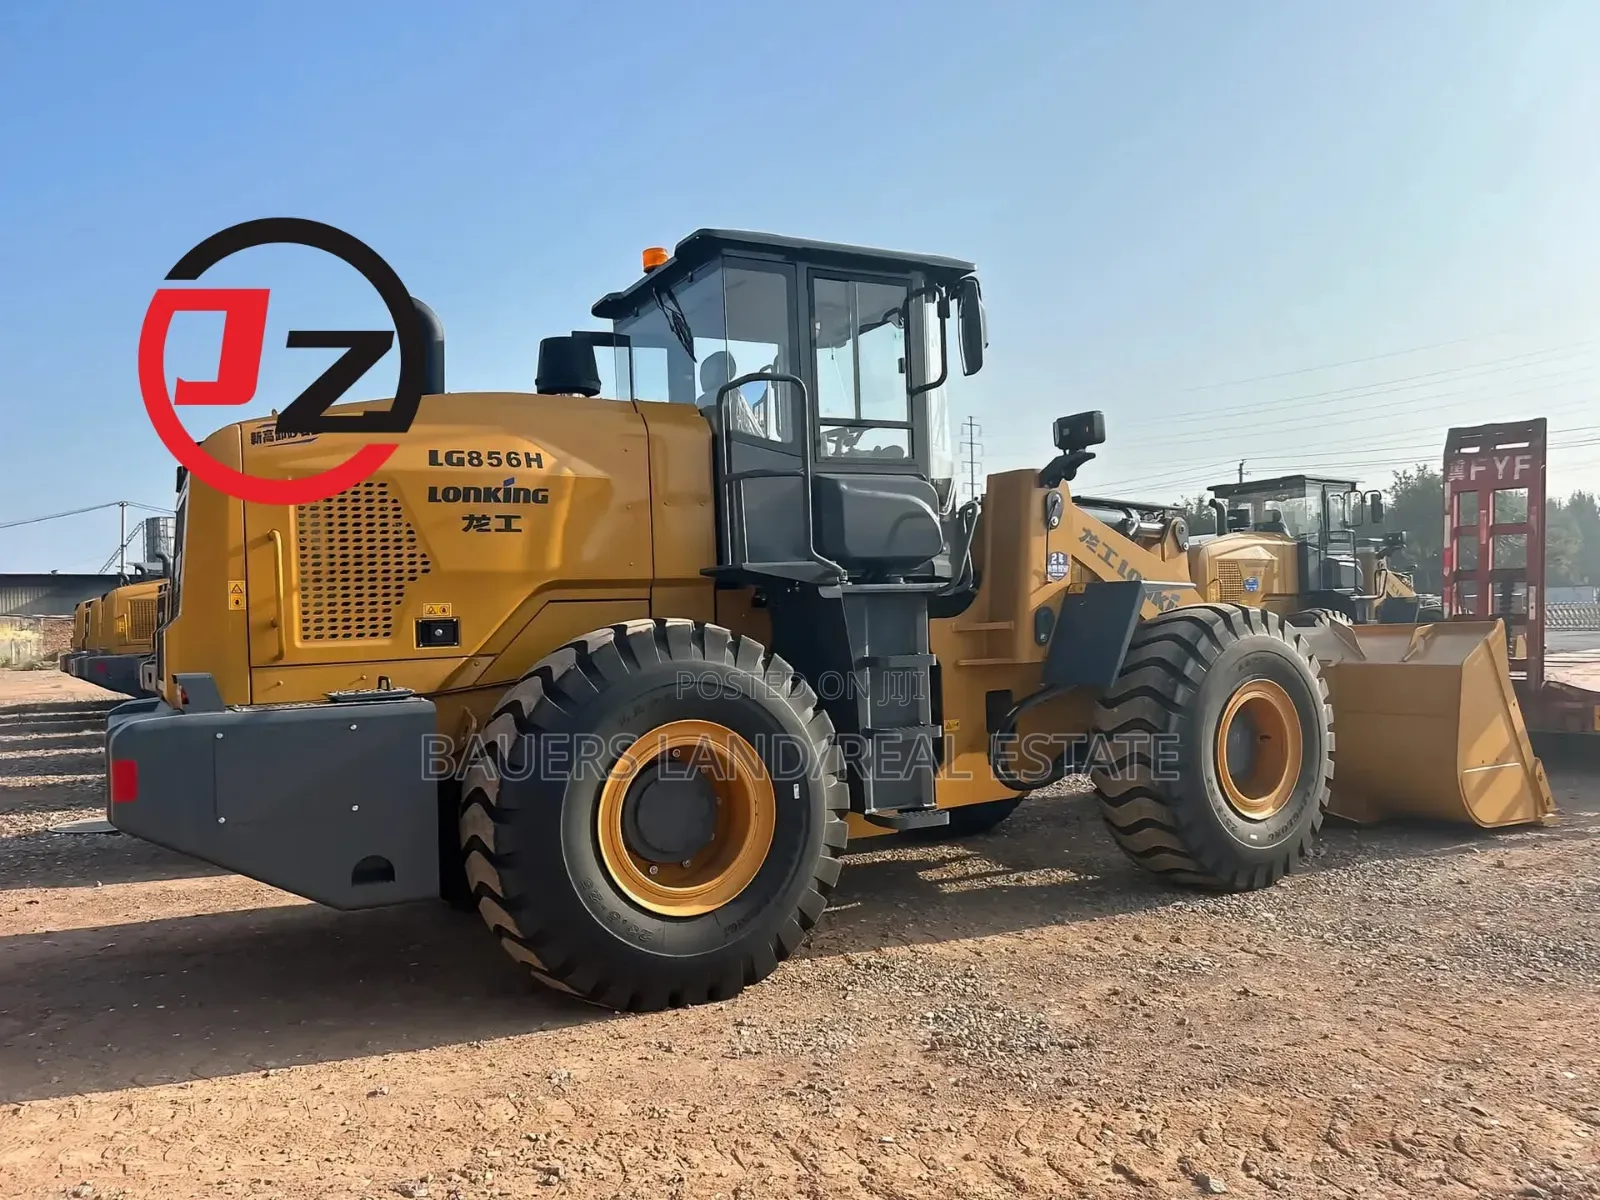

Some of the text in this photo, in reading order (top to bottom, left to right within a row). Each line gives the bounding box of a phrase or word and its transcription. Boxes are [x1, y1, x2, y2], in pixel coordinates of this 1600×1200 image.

[428, 449, 543, 469] LG856H
[461, 514, 522, 533] 龙工
[1079, 527, 1119, 569] 龙工
